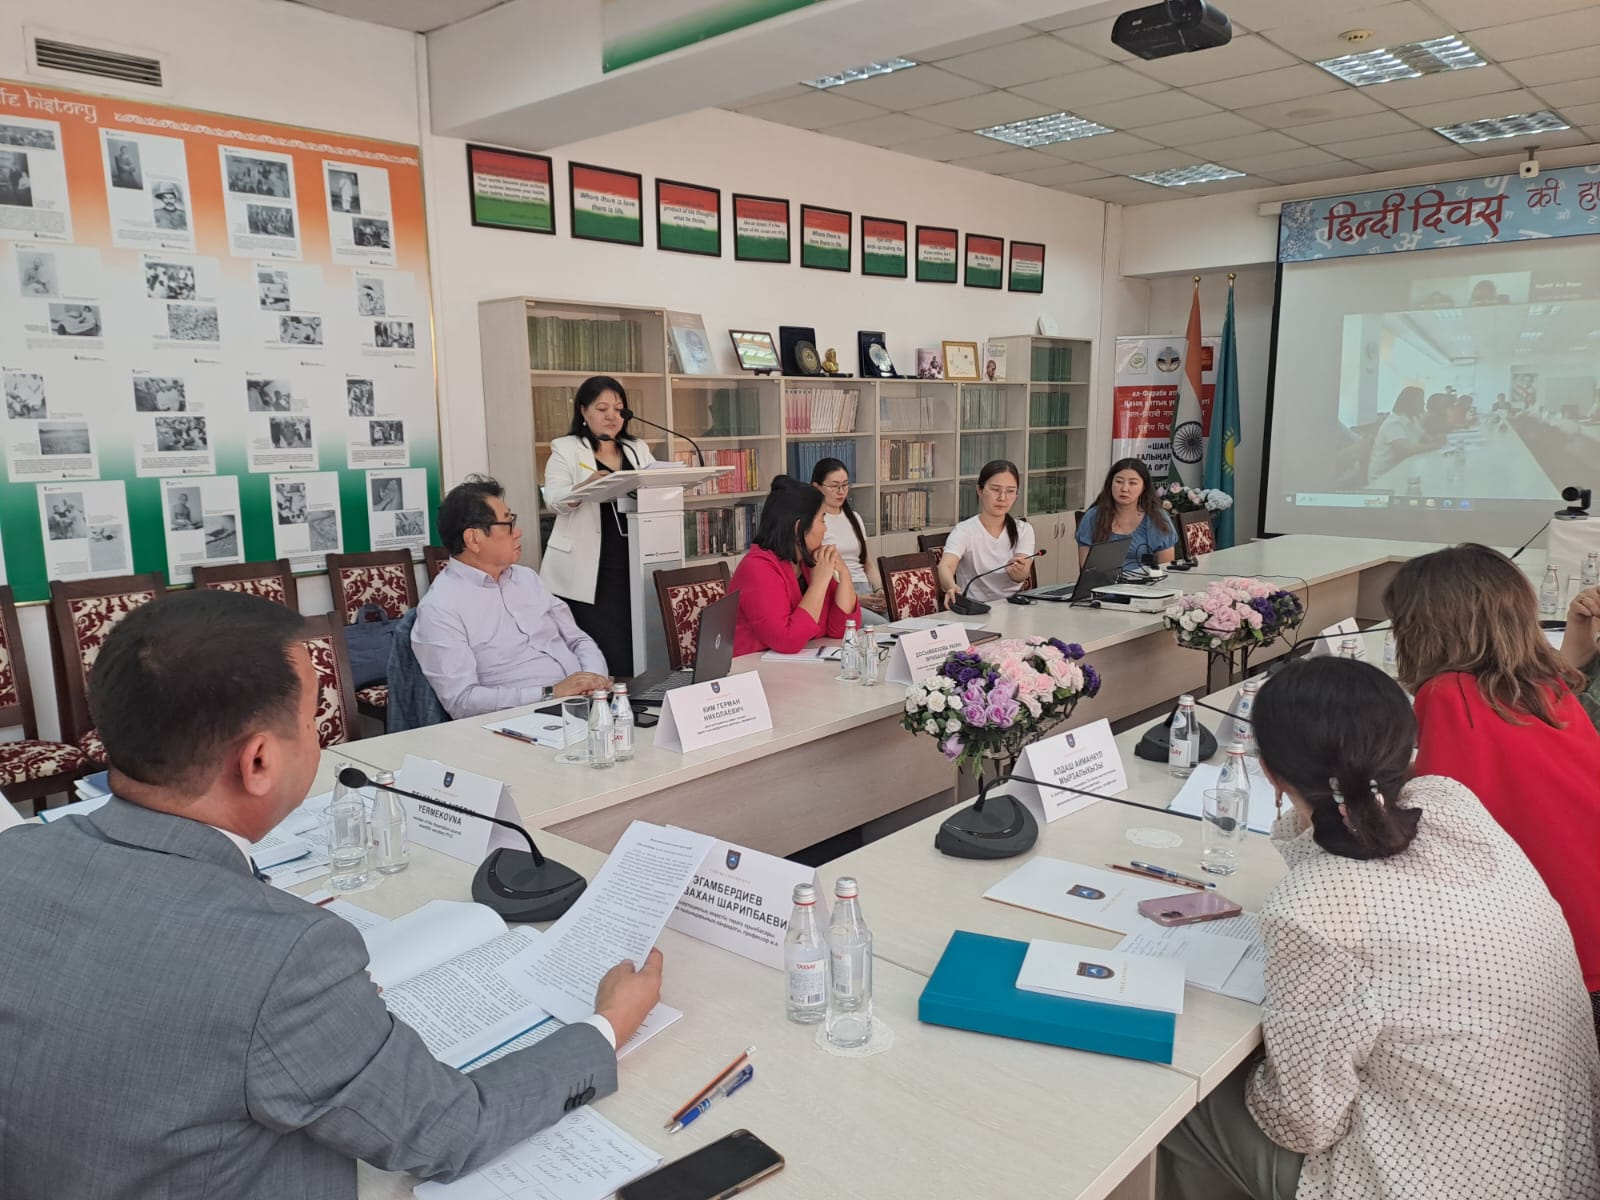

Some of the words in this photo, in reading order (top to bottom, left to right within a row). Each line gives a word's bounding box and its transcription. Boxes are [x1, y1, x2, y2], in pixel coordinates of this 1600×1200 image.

[0, 88, 20, 107] fe
[24, 89, 98, 124] history
[580, 191, 599, 201] Where
[601, 194, 616, 204] there
[623, 199, 636, 207] love
[591, 203, 607, 213] there
[1322, 193, 1405, 242] हिन्दी
[1407, 189, 1510, 238] दिवस
[1526, 177, 1561, 208] की
[702, 704, 716, 713] КИМ
[716, 698, 741, 710] ГЕРМАН
[703, 707, 744, 720] НИКОЛАЕВИЧ
[418, 803, 463, 825] YERMEKOVNA
[692, 874, 763, 906] ЭГАМБЕРДИЕВ
